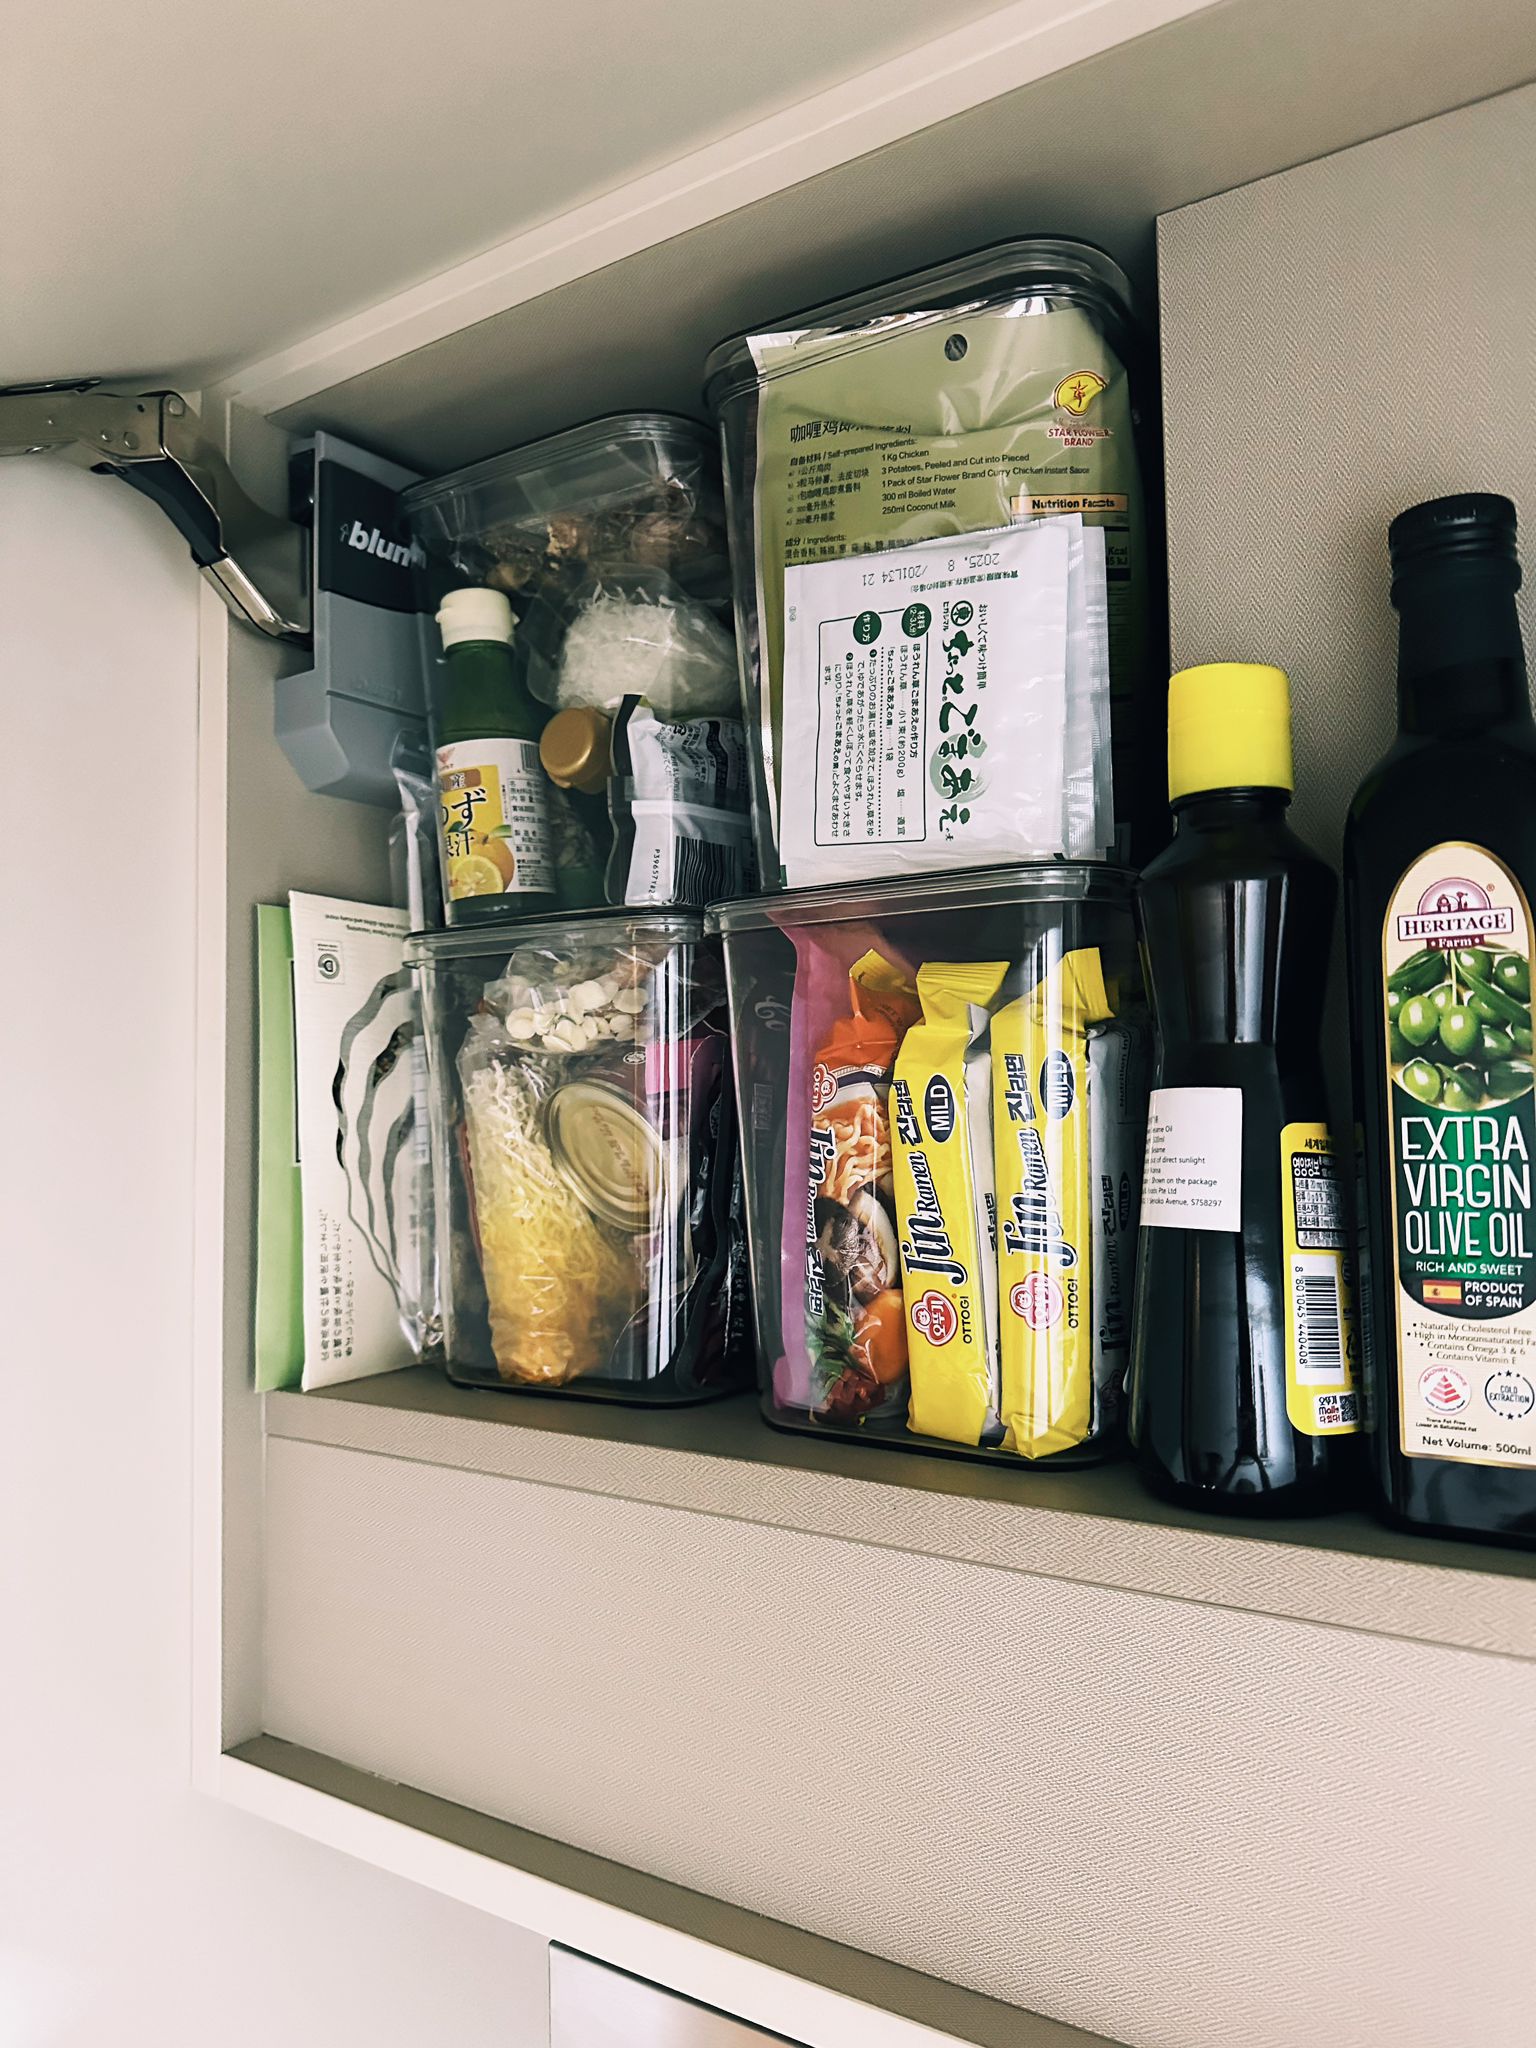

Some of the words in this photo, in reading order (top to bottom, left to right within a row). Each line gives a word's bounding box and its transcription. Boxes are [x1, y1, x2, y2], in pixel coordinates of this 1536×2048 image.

[1048, 428, 1072, 438] STAR
[1063, 438, 1094, 447] BRAND
[827, 443, 874, 459] Self-prepared
[875, 438, 918, 452] Ingredients:
[887, 454, 897, 462] Kg
[899, 449, 930, 459] Chicken
[882, 467, 887, 475] 3
[888, 464, 922, 474] Potatoes,
[925, 460, 951, 470] Peeled
[953, 456, 968, 466] and
[969, 456, 984, 465] Cut
[985, 455, 1000, 464] into
[1002, 453, 1030, 462] Pieced
[887, 478, 907, 487] Pack
[907, 476, 915, 484] of
[916, 474, 932, 483] Star
[934, 472, 960, 483] Flower
[962, 469, 985, 479] Brand
[987, 467, 1011, 478] Curry
[1012, 466, 1043, 475] Chicken
[1044, 466, 1068, 474] Instant
[1069, 466, 1090, 474] Sauce
[882, 493, 896, 501] 300
[898, 491, 907, 499] ml
[908, 489, 932, 499] Boiled
[933, 487, 957, 497] Water
[1032, 499, 1079, 509] Nutrition
[1082, 498, 1115, 508] Facts
[882, 505, 905, 515] 250ml
[906, 502, 938, 512] Coconut
[940, 500, 956, 509] Milk
[348, 520, 427, 570] blum
[807, 534, 847, 544] Ingredients:
[948, 559, 955, 572] 8
[965, 552, 1000, 569] 2025.
[862, 573, 875, 587] 21
[917, 610, 926, 630] 材料
[942, 601, 950, 632] ヒガシマル
[862, 613, 870, 642] 作り方
[976, 603, 988, 689] おいしくて味つけ簡単
[824, 665, 832, 686] ます。
[909, 643, 921, 759] ほうれん草ごまあえの作り方
[1404, 912, 1507, 936] HERITAGE
[1438, 936, 1472, 948] Farm
[1005, 1053, 1036, 1122] 진라면
[1050, 1060, 1070, 1109] MILD
[1119, 1054, 1127, 1107] Nutrition
[894, 1080, 923, 1146] 진라면
[930, 1084, 950, 1132] MILD
[1401, 1116, 1529, 1161] EXTRA
[1022, 1128, 1047, 1191] Ramen
[1179, 1156, 1206, 1165] sunlight
[1293, 1157, 1320, 1177] 영양정보
[909, 1151, 940, 1215] Ramen
[1188, 1178, 1218, 1187] package
[1403, 1163, 1531, 1209] VIRGIN
[1101, 1174, 1118, 1236] 진라면
[1119, 1180, 1130, 1221] MILD
[1191, 1198, 1222, 1207] S758297
[1004, 1193, 1078, 1266] Jin
[1404, 1211, 1481, 1257] OLIVE
[1489, 1212, 1533, 1258] OIL
[902, 1214, 968, 1286] Jin
[1415, 1261, 1444, 1273] RICH
[1447, 1262, 1476, 1275] AND
[1479, 1264, 1523, 1276] SWEET
[806, 1248, 824, 1315] 진라면
[1464, 1281, 1524, 1295] PRODUCT
[1068, 1278, 1079, 1329] OTTOGI
[1295, 1278, 1306, 1318] 801045
[1465, 1294, 1483, 1306] OF
[1486, 1296, 1522, 1309] SPAIN
[930, 1302, 947, 1337] 오뚜기
[963, 1295, 972, 1344] OTTOGI
[1420, 1322, 1459, 1334] Naturally
[1461, 1323, 1510, 1334] Cholesterol
[1513, 1327, 1532, 1335] Free
[1298, 1323, 1308, 1365] 440408
[1415, 1331, 1435, 1340] High
[1437, 1332, 1446, 1340] in
[1448, 1333, 1523, 1346] Monounsaturated
[1427, 1341, 1464, 1351] Contains
[1466, 1343, 1499, 1355] Omega
[1502, 1346, 1507, 1354] 3
[1510, 1347, 1517, 1355] &
[1520, 1347, 1526, 1355] 6
[1436, 1351, 1474, 1362] Contains
[1475, 1354, 1509, 1364] Vitamin
[1511, 1357, 1517, 1365] E
[1489, 1392, 1530, 1404] EXTRACTION
[1499, 1385, 1518, 1394] COLD
[1422, 1435, 1446, 1447] Net
[1446, 1437, 1493, 1452] Volume:
[1495, 1442, 1532, 1456] 500ml
